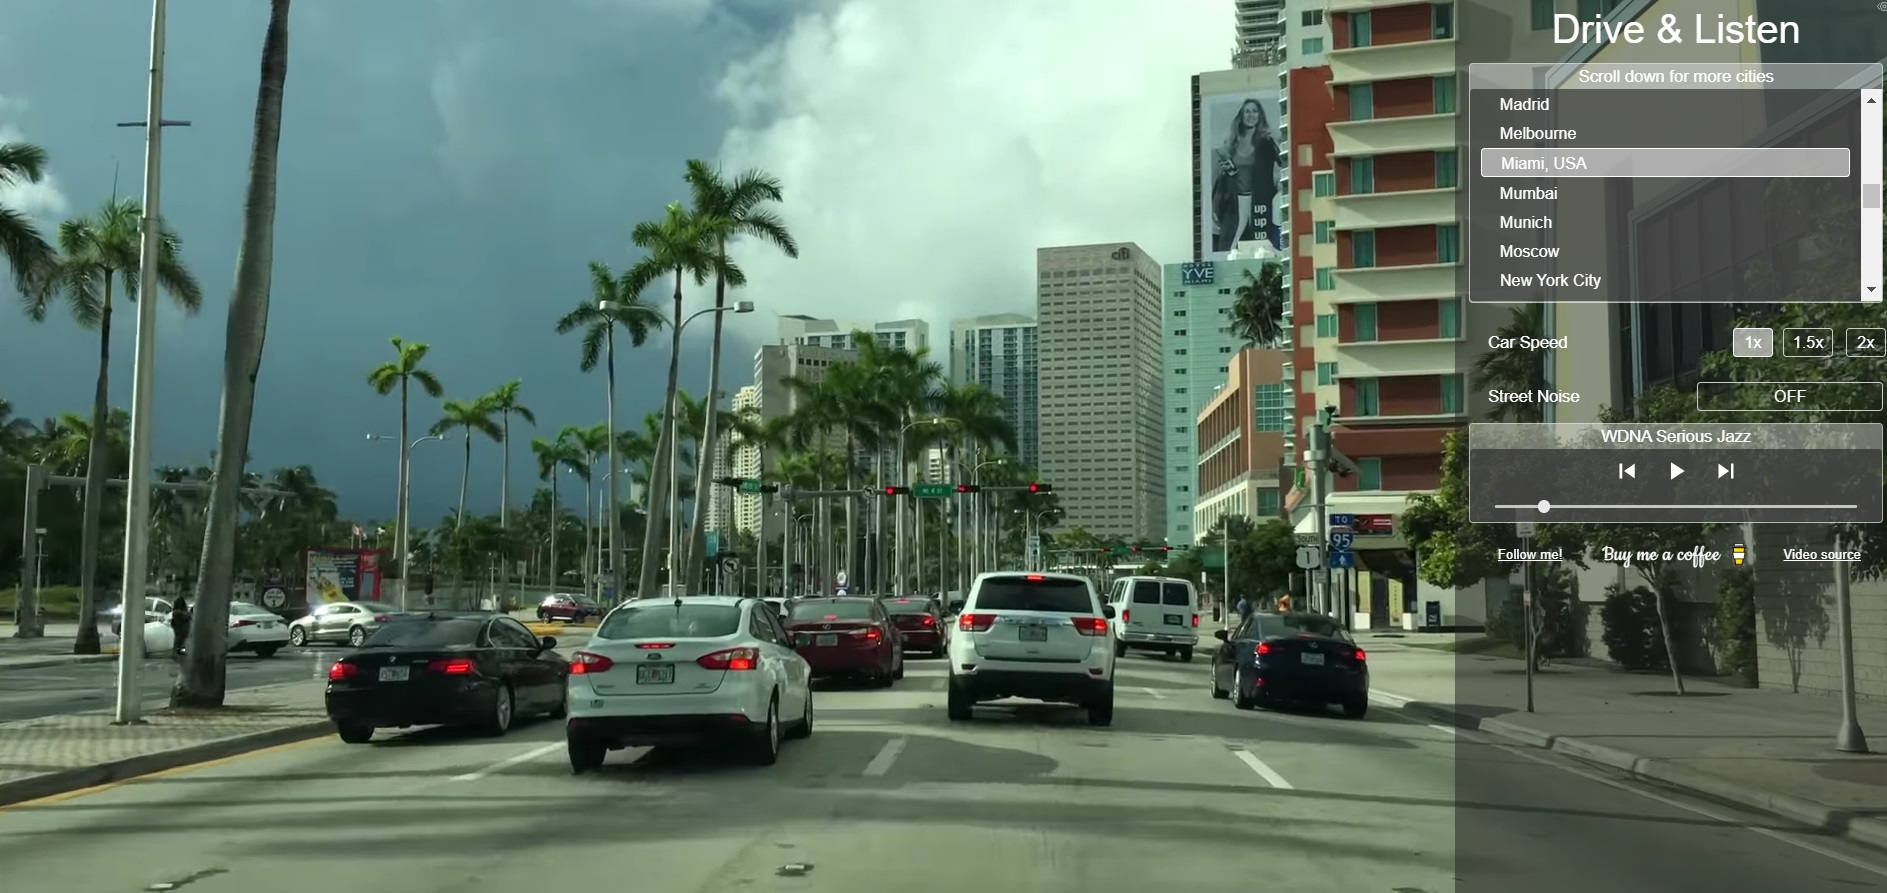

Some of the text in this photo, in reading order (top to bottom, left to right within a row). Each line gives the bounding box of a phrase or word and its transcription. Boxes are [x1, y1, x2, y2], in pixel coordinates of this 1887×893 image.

[1254, 205, 1267, 215] up
[1254, 218, 1267, 228] up
[1183, 267, 1213, 279] YVE
[1335, 516, 1348, 524] TO
[1333, 534, 1350, 548] 95
[1306, 551, 1310, 565] 1
